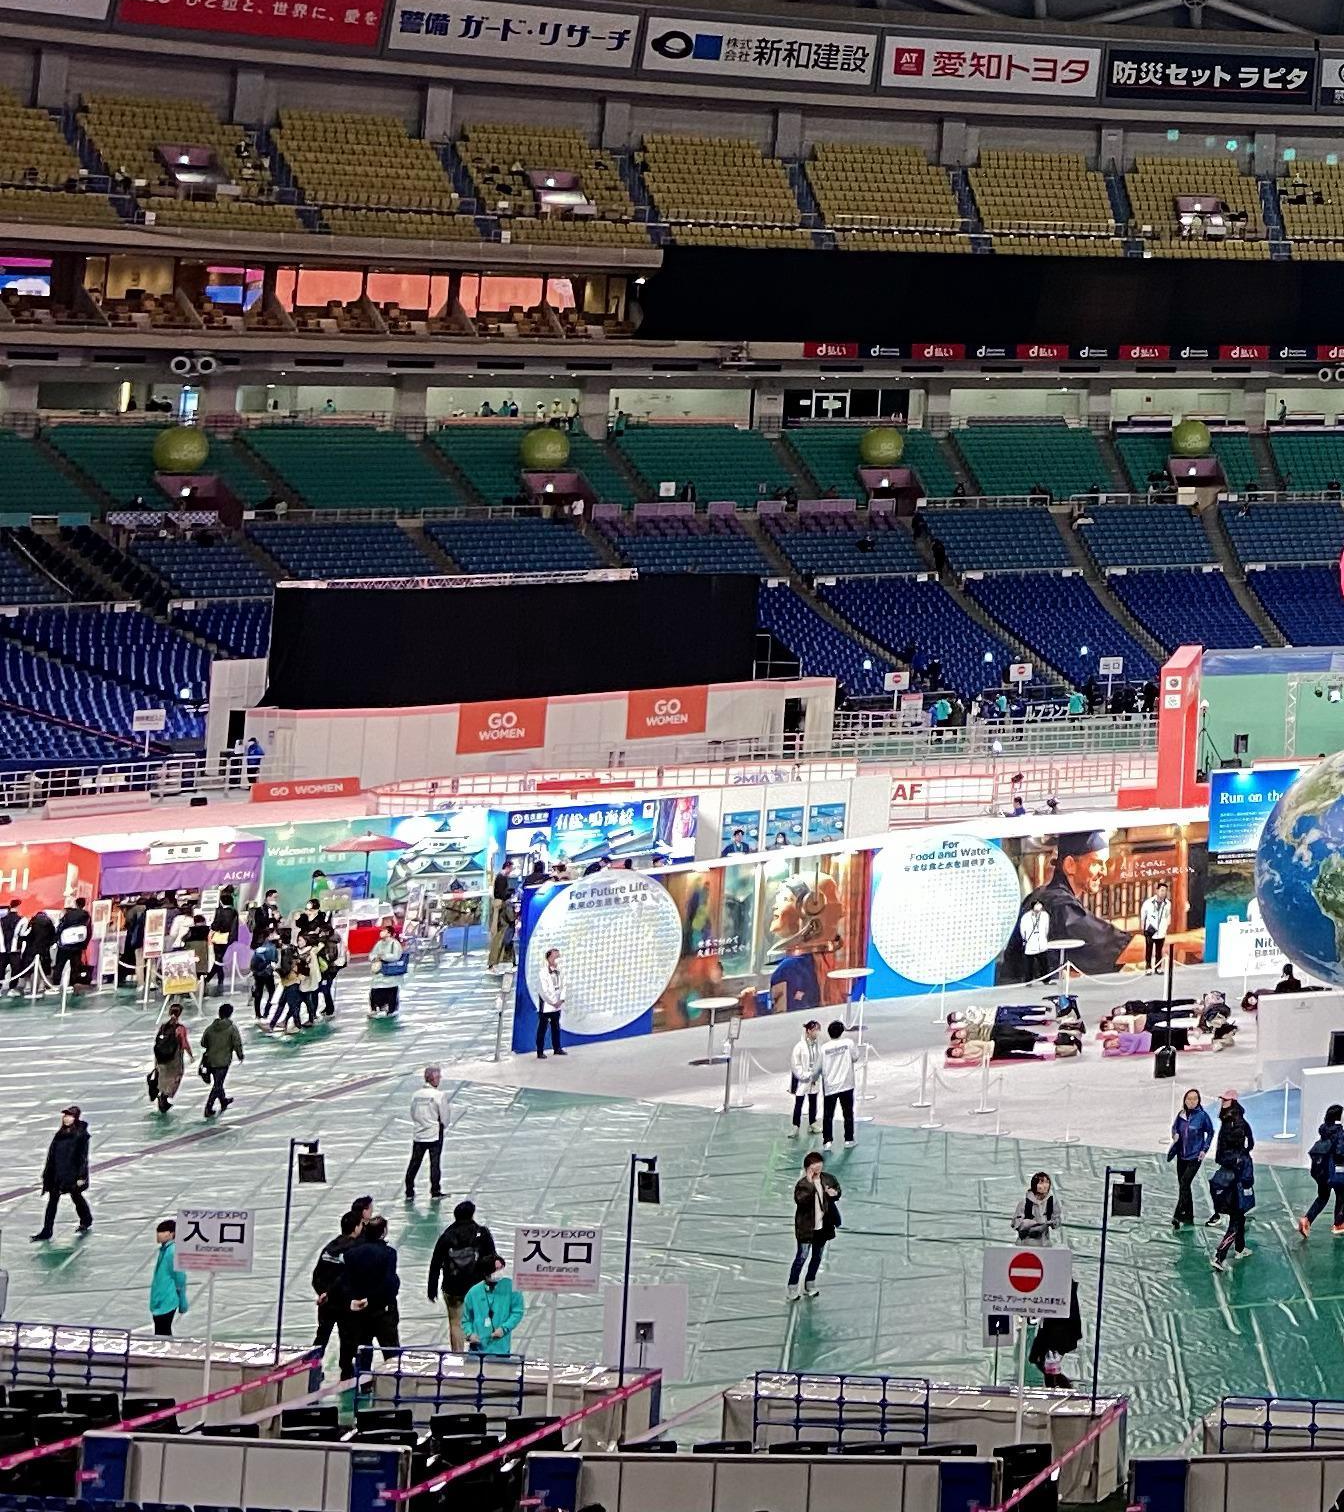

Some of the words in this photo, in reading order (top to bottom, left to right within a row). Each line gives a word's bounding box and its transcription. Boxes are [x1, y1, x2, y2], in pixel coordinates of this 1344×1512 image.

[459, 15, 631, 51] ガード・リサーチ
[752, 37, 870, 74] 新和建設
[932, 51, 1091, 84] 愛知トヨタ
[1112, 60, 1231, 88] 防災セット
[1238, 66, 1308, 89] ラピタ
[654, 698, 681, 715] GO
[488, 711, 518, 729] GO
[646, 713, 688, 727] WOMEN
[478, 727, 526, 741] WOMEN
[270, 786, 289, 797] GO
[294, 782, 345, 796] WOMEN
[1219, 792, 1244, 804] Run
[1249, 793, 1263, 803] on
[268, 846, 317, 859] Welcome
[909, 850, 935, 862] Food
[938, 848, 957, 859] and
[961, 845, 992, 857] Water
[942, 840, 960, 850] For
[569, 889, 587, 900] For
[590, 884, 626, 898] Future
[628, 881, 650, 893] Life
[181, 1209, 248, 1220] マラソンEXPO
[183, 1221, 245, 1244] 入口
[521, 1229, 596, 1239] マラソンEXPO
[522, 1240, 592, 1264] 入口
[536, 1264, 580, 1273] Entrance
